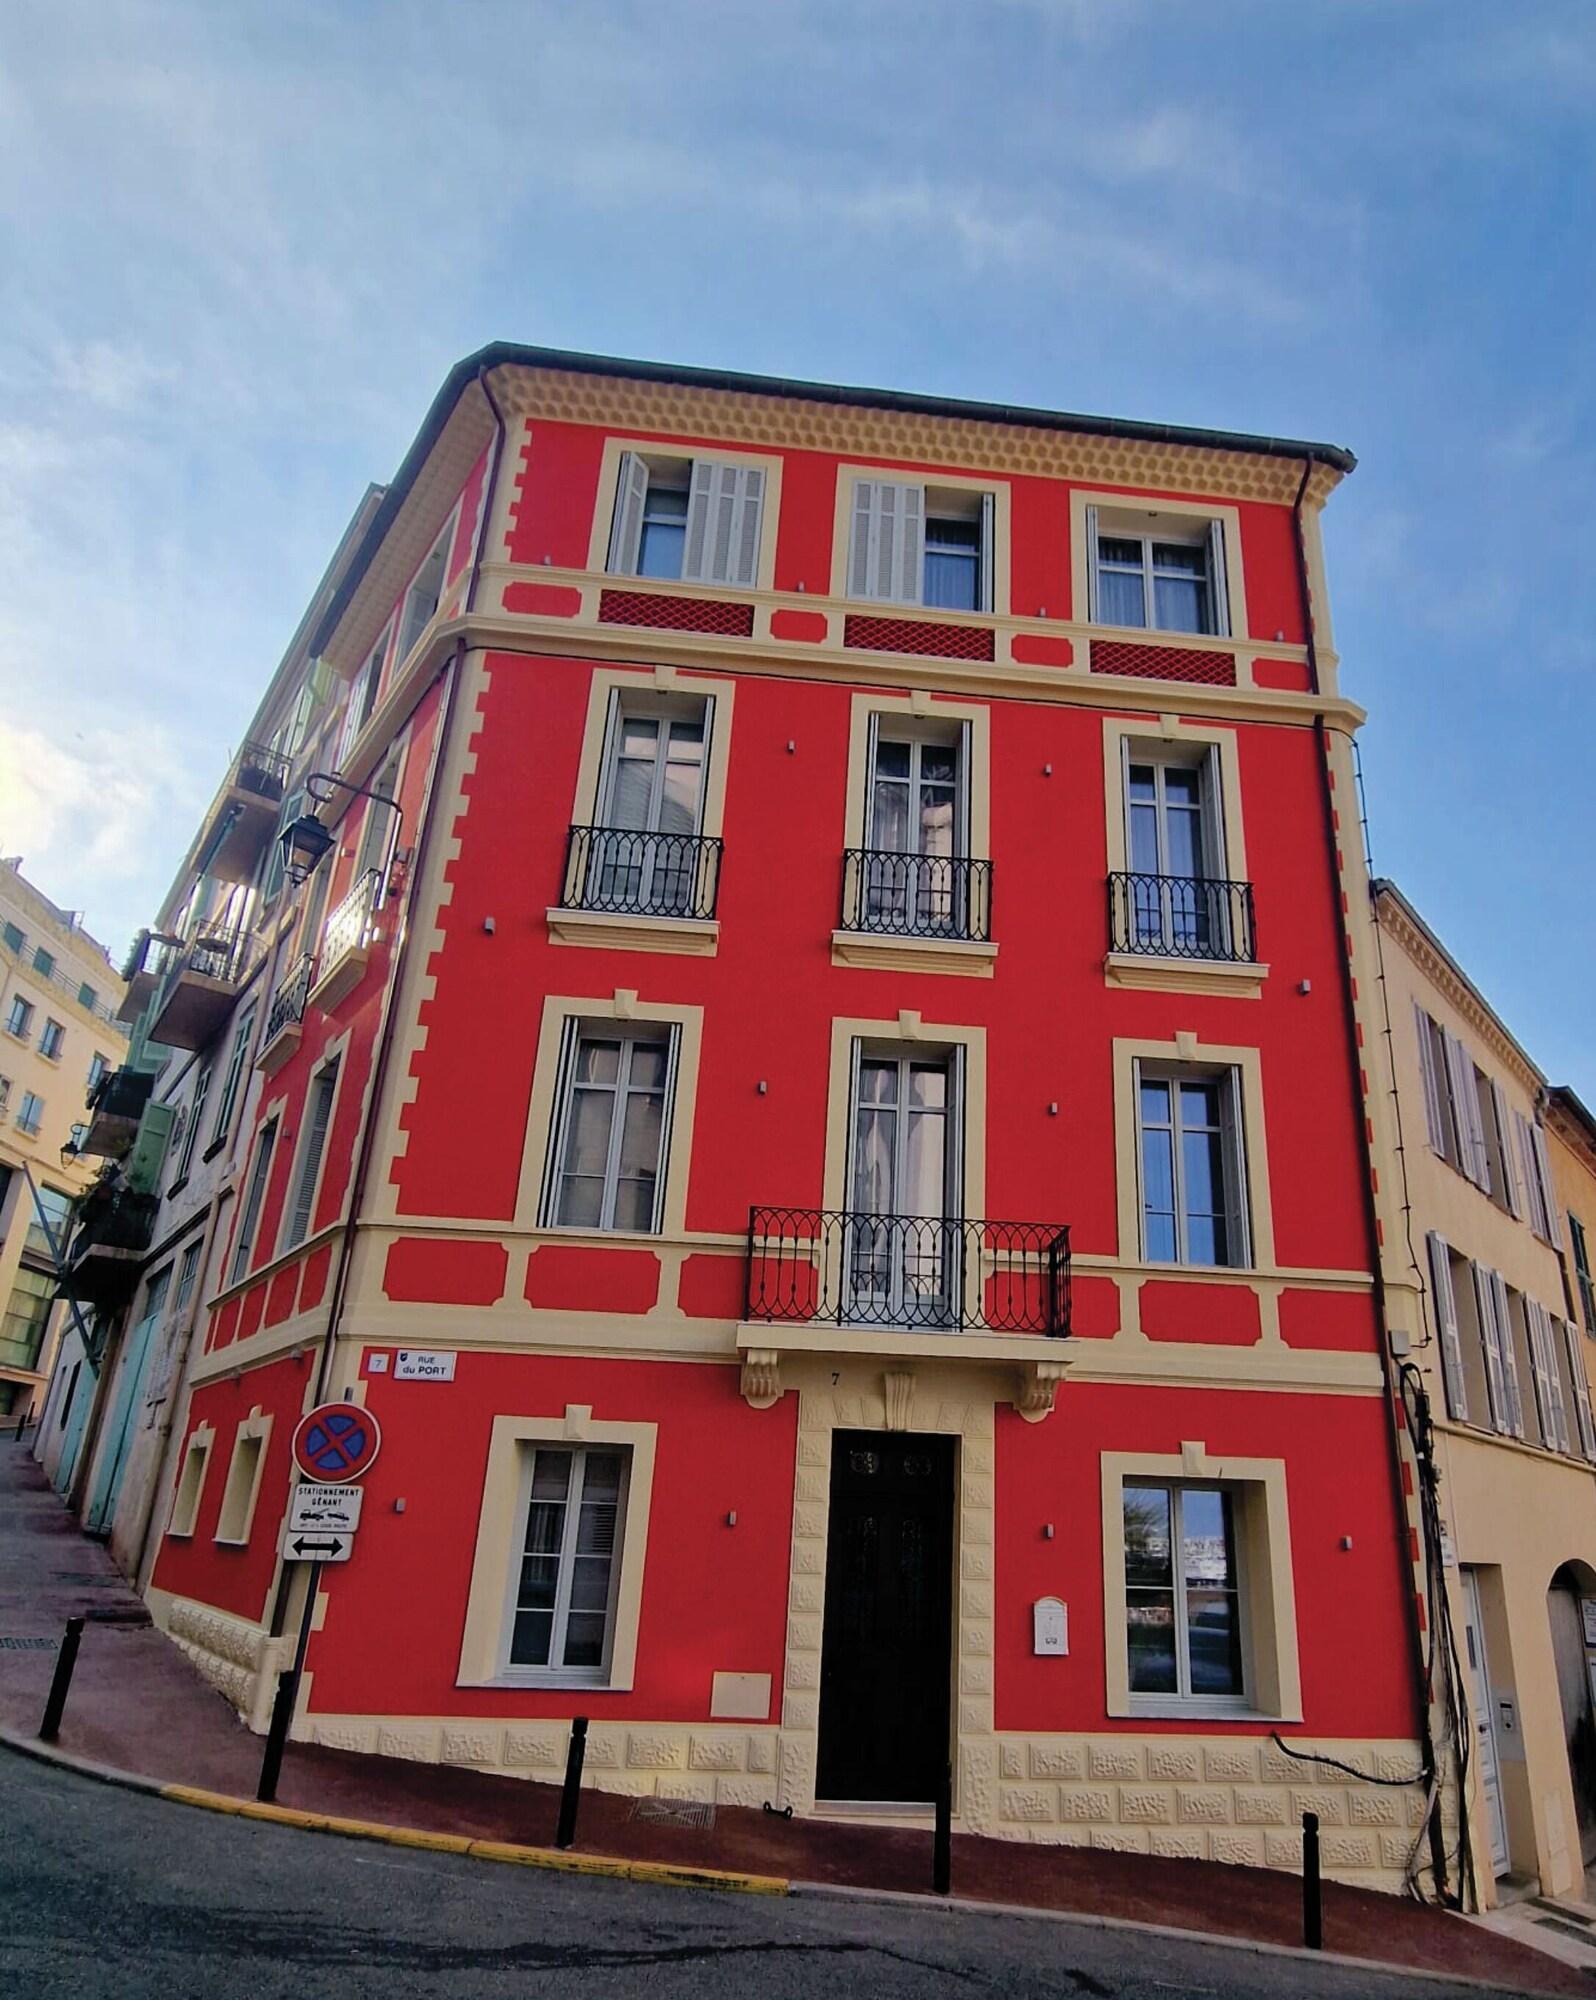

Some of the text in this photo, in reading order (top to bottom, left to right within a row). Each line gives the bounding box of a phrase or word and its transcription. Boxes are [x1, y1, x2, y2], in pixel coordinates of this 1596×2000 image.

[375, 1359, 383, 1369] 7
[417, 1356, 436, 1364] RUE
[402, 1366, 447, 1375] du PORT
[831, 1372, 840, 1386] 7
[298, 1487, 360, 1496] STATIONNEMENT
